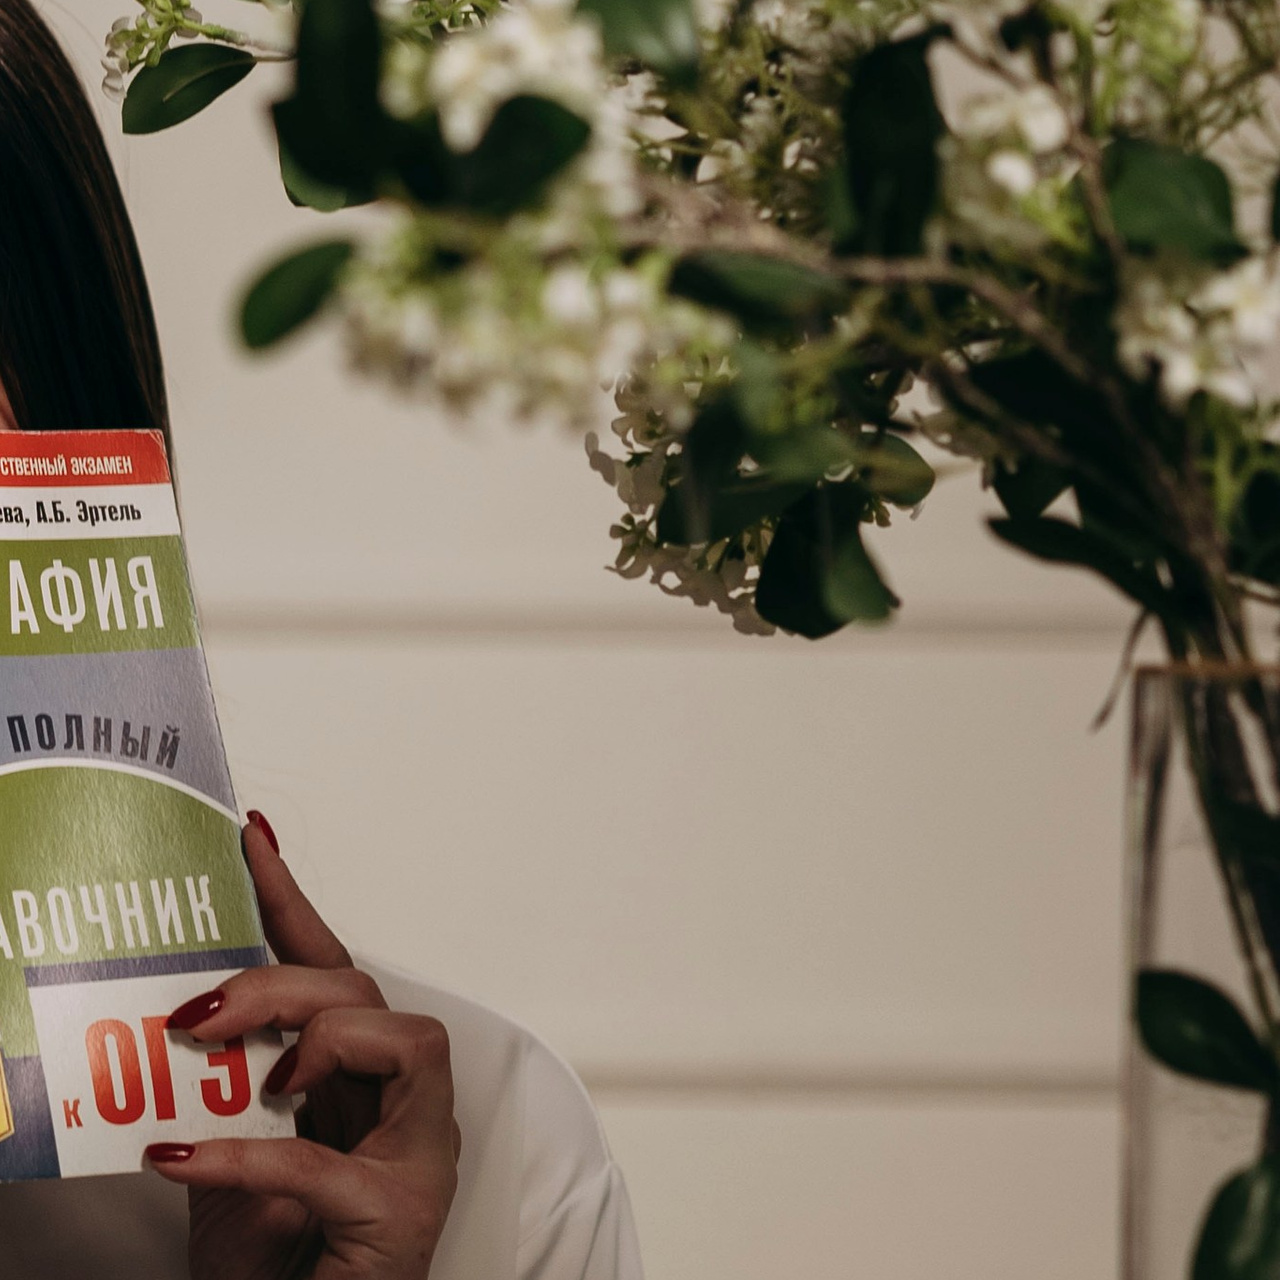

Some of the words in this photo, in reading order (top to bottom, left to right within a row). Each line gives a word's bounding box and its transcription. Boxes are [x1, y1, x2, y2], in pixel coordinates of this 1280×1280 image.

[71, 455, 133, 476] ЭКЗАМЕН
[36, 500, 70, 524] А.Б.
[77, 500, 142, 526] Эртель
[6, 713, 181, 770] ПОЛНЫЙ
[85, 1015, 252, 1126] ОГЭ
